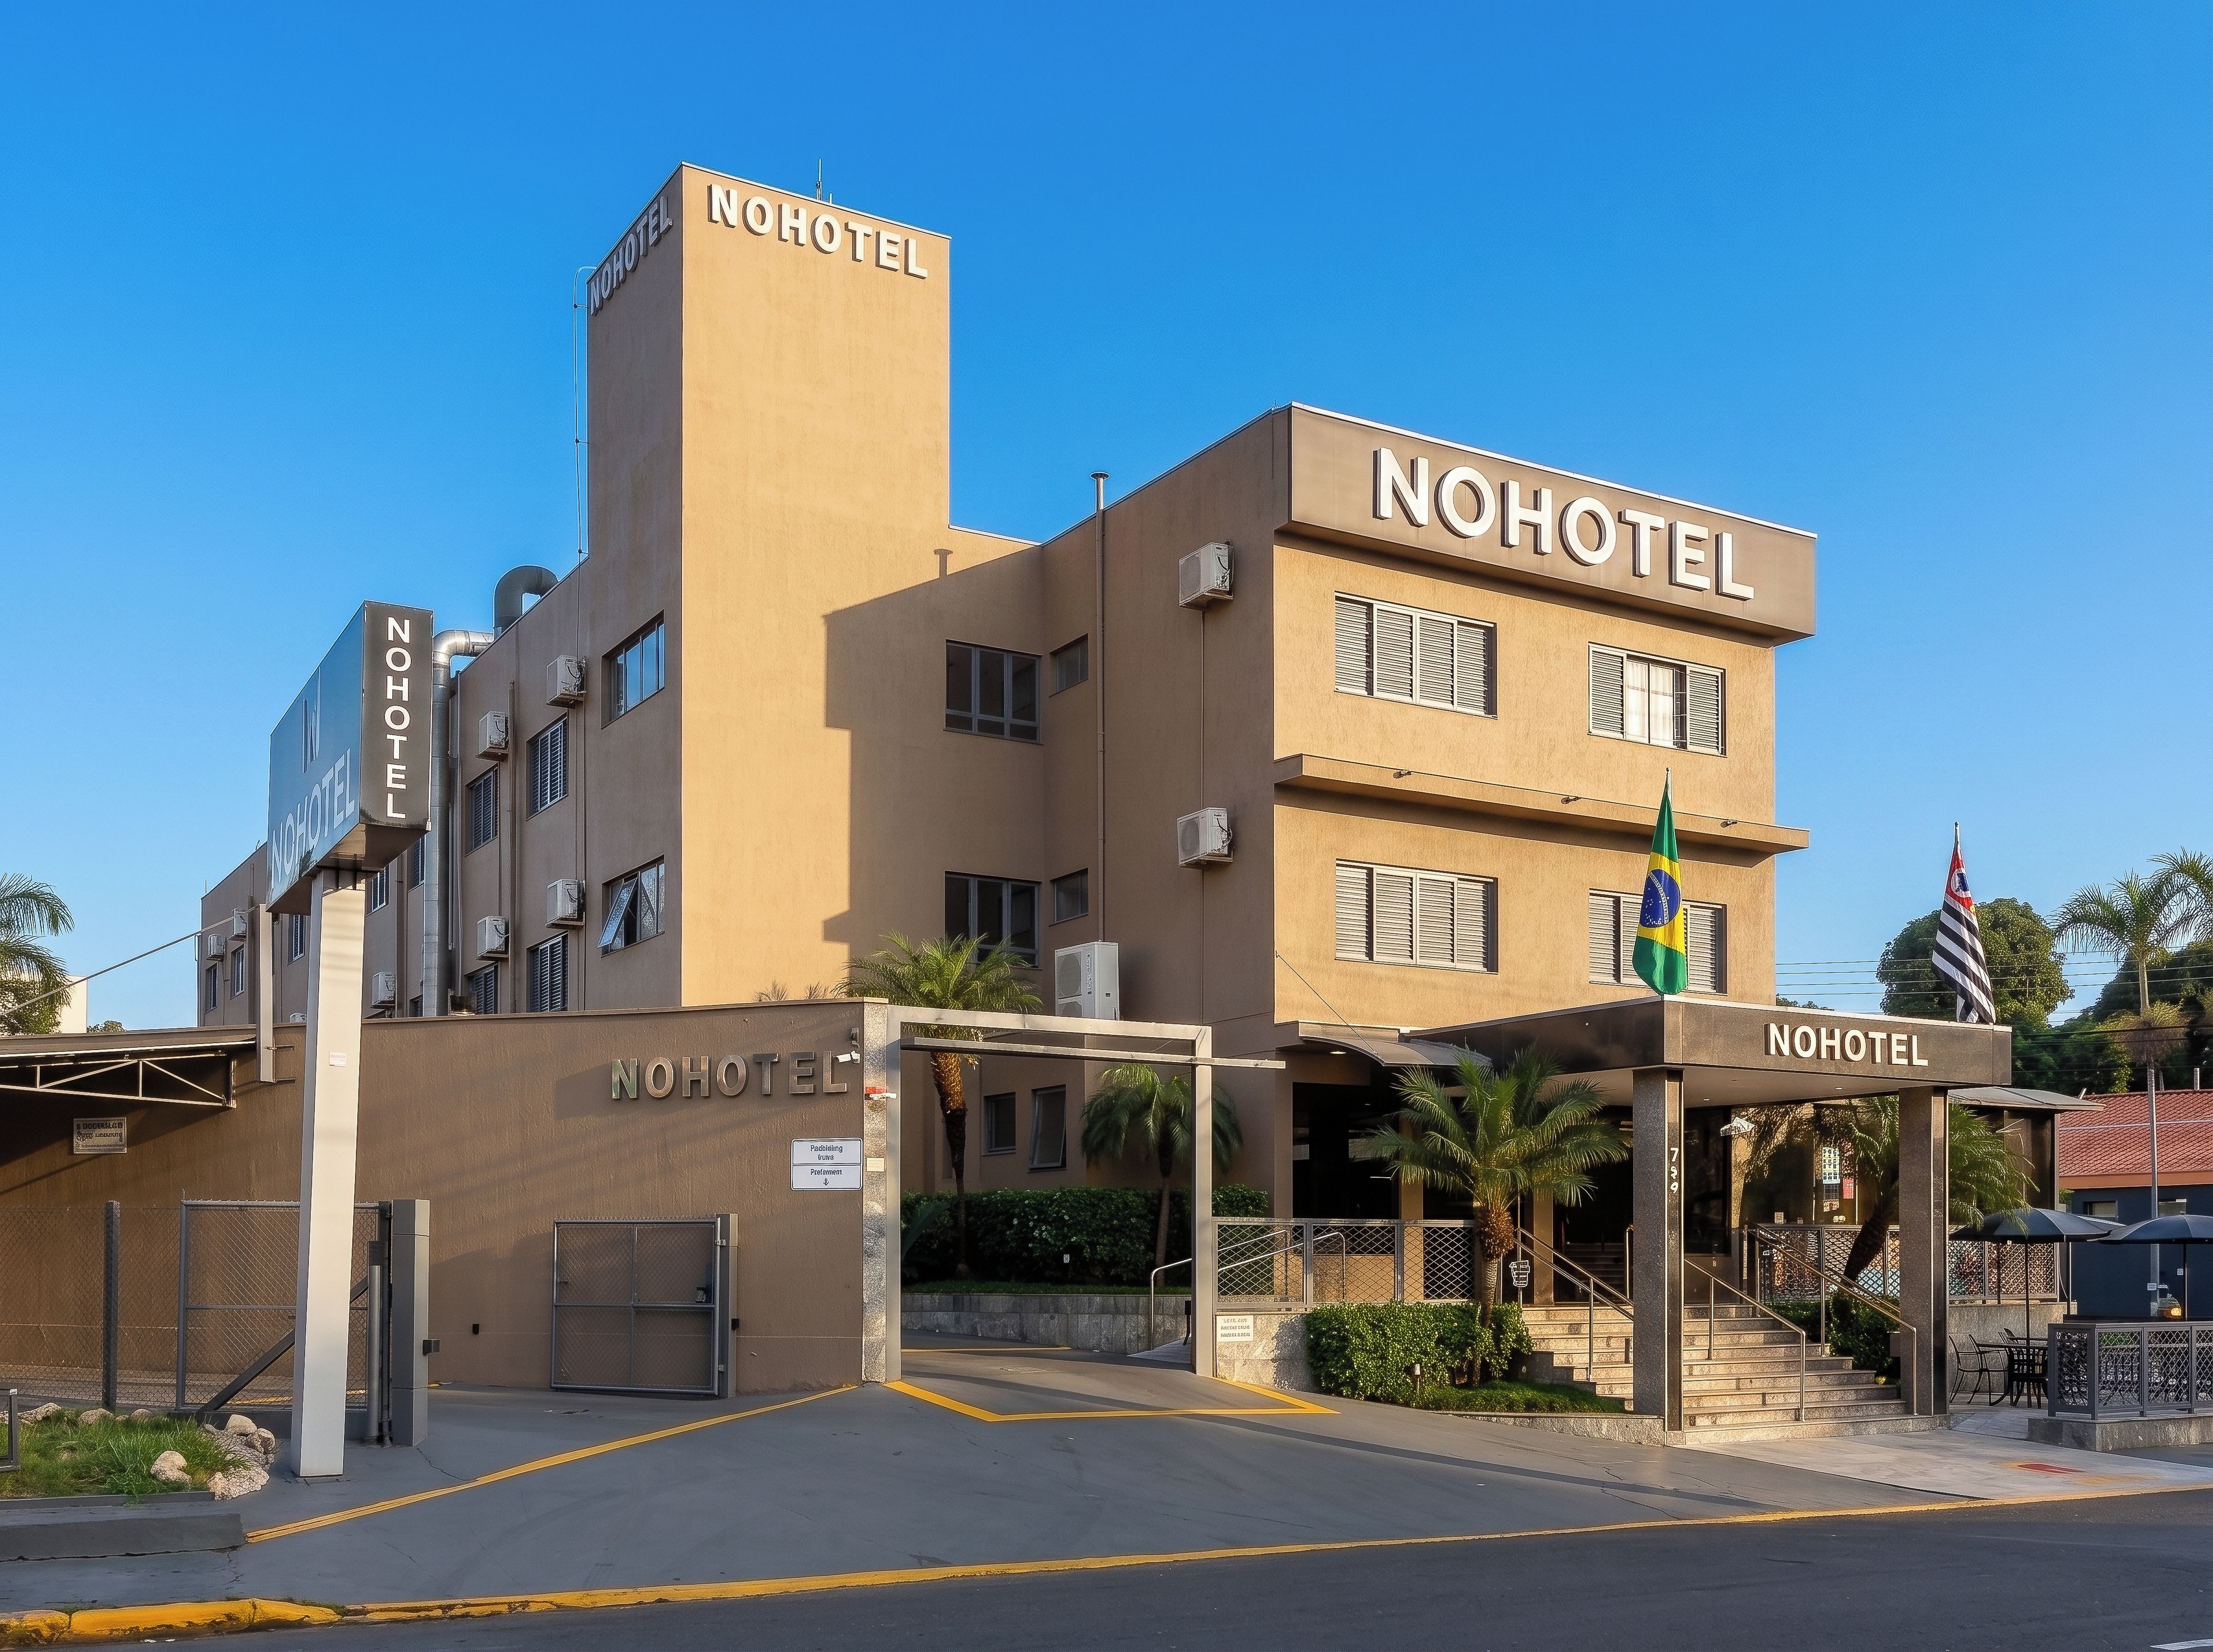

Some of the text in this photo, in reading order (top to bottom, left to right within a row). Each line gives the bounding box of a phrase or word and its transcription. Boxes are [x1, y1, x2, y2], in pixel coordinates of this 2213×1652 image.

[590, 196, 673, 316] NOHOTEL
[708, 184, 928, 279] NOHOTEL
[1372, 447, 1755, 602] NOHOTEL
[384, 617, 412, 820] NOHOTEL
[271, 747, 355, 890] NOHOTEL
[611, 1050, 848, 1099] NOHOTEL
[1764, 1022, 1929, 1067] NOHOTEL
